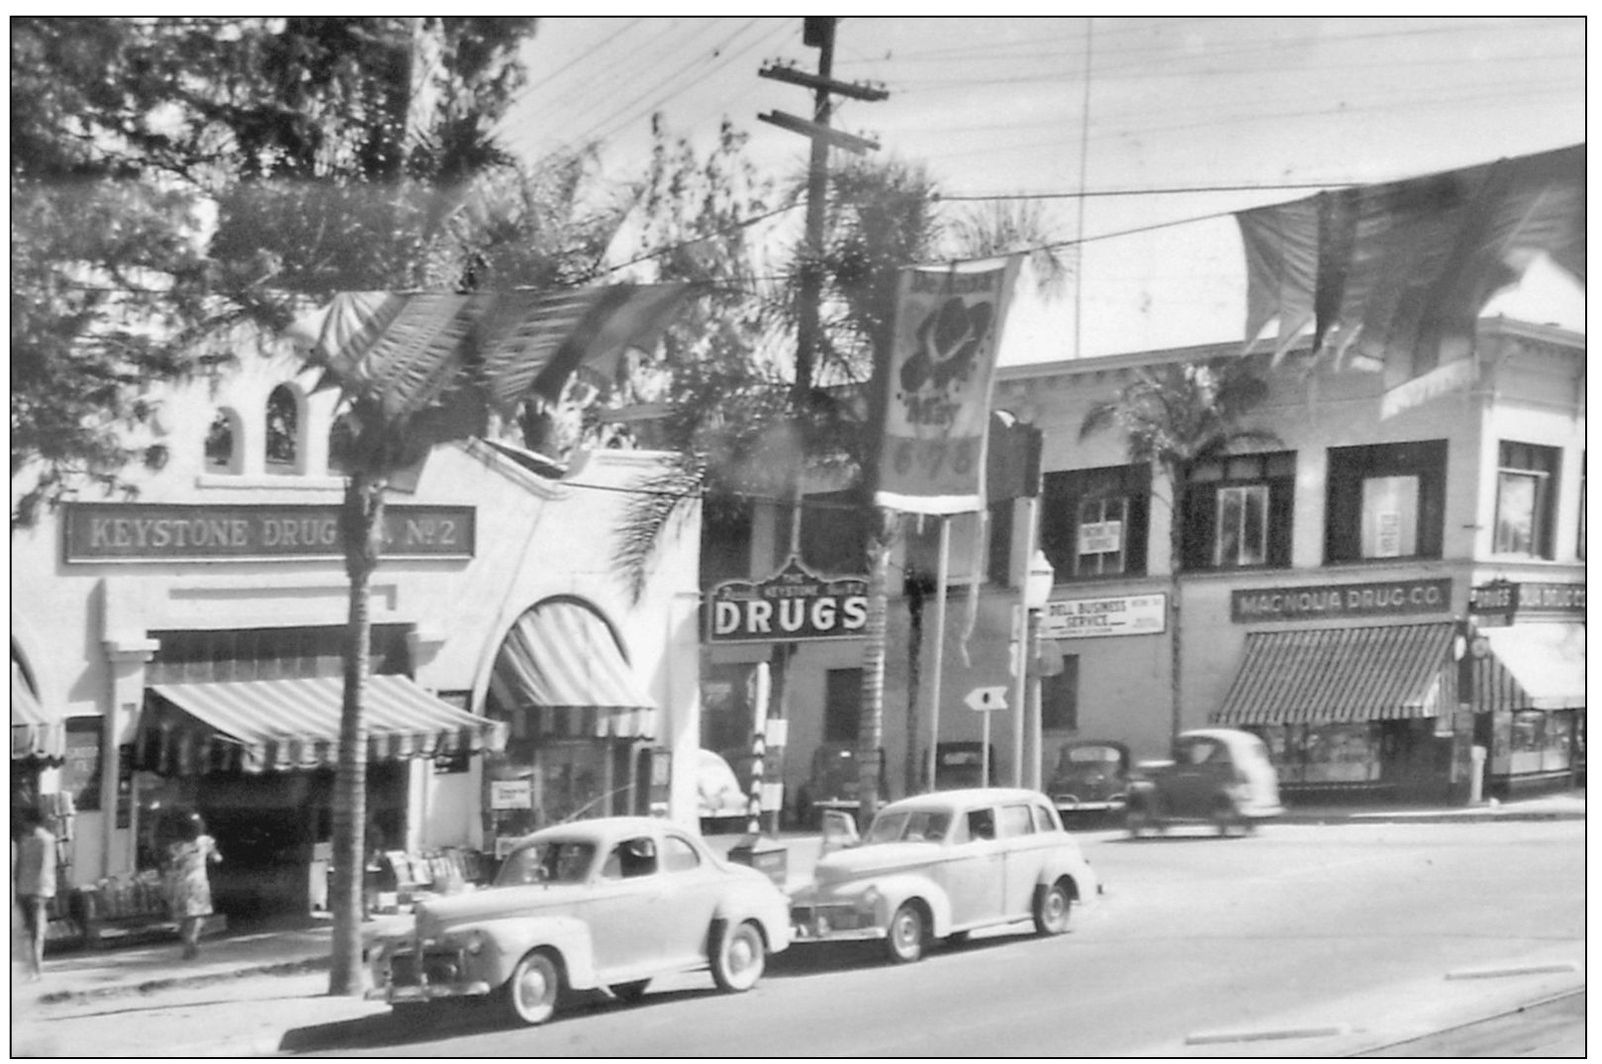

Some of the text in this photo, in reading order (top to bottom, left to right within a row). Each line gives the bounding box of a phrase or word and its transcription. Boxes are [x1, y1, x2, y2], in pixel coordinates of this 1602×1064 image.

[89, 517, 249, 548] KEYSTONE
[263, 517, 338, 547] DRUG
[1078, 600, 1126, 615] BUSINESS
[1239, 591, 1342, 615] MAGNOLIA
[1347, 588, 1406, 609] DRUG
[714, 596, 868, 635] DRUGS
[1066, 614, 1108, 628] SERVICE
